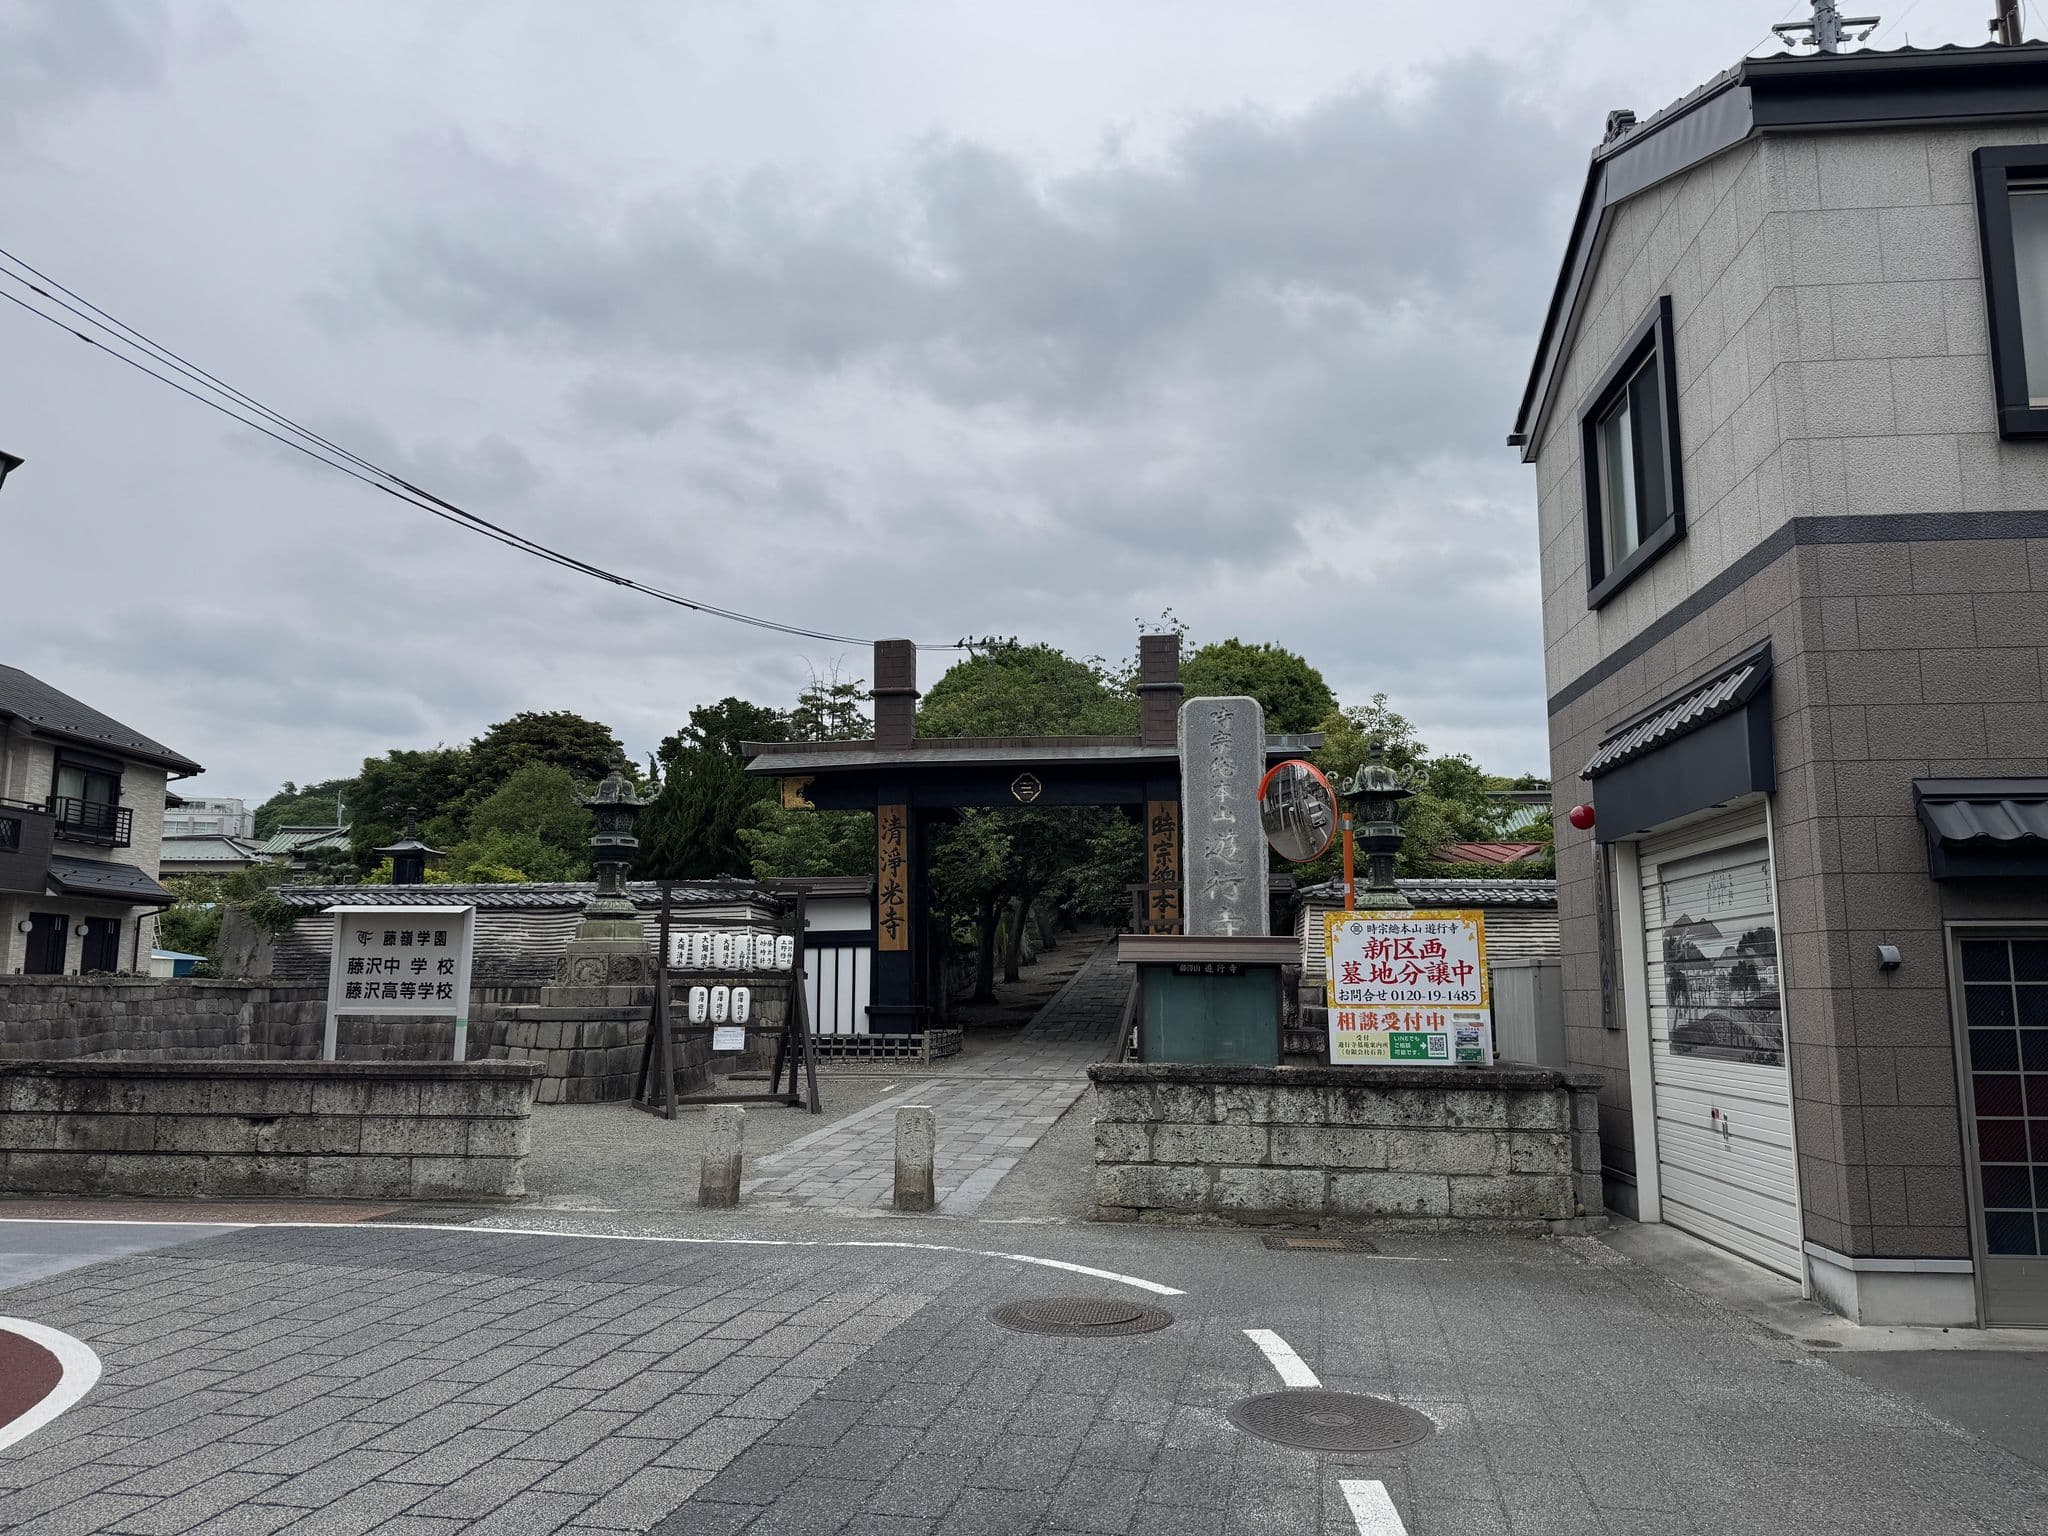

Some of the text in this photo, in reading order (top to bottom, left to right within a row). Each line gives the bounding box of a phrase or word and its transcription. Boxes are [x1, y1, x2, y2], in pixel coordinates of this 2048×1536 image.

[1425, 923, 1459, 935] 遊行寺
[382, 930, 448, 947] 藤嶺学園
[1361, 936, 1447, 961] 新区画
[347, 957, 455, 975] 藤沢中学校
[1340, 960, 1474, 987] 墓地分譲中
[345, 982, 453, 1000] 藤沢高等学校
[1338, 989, 1476, 1001] お問合せ 0120-19-1485
[1336, 1012, 1446, 1032] 相談受付中
